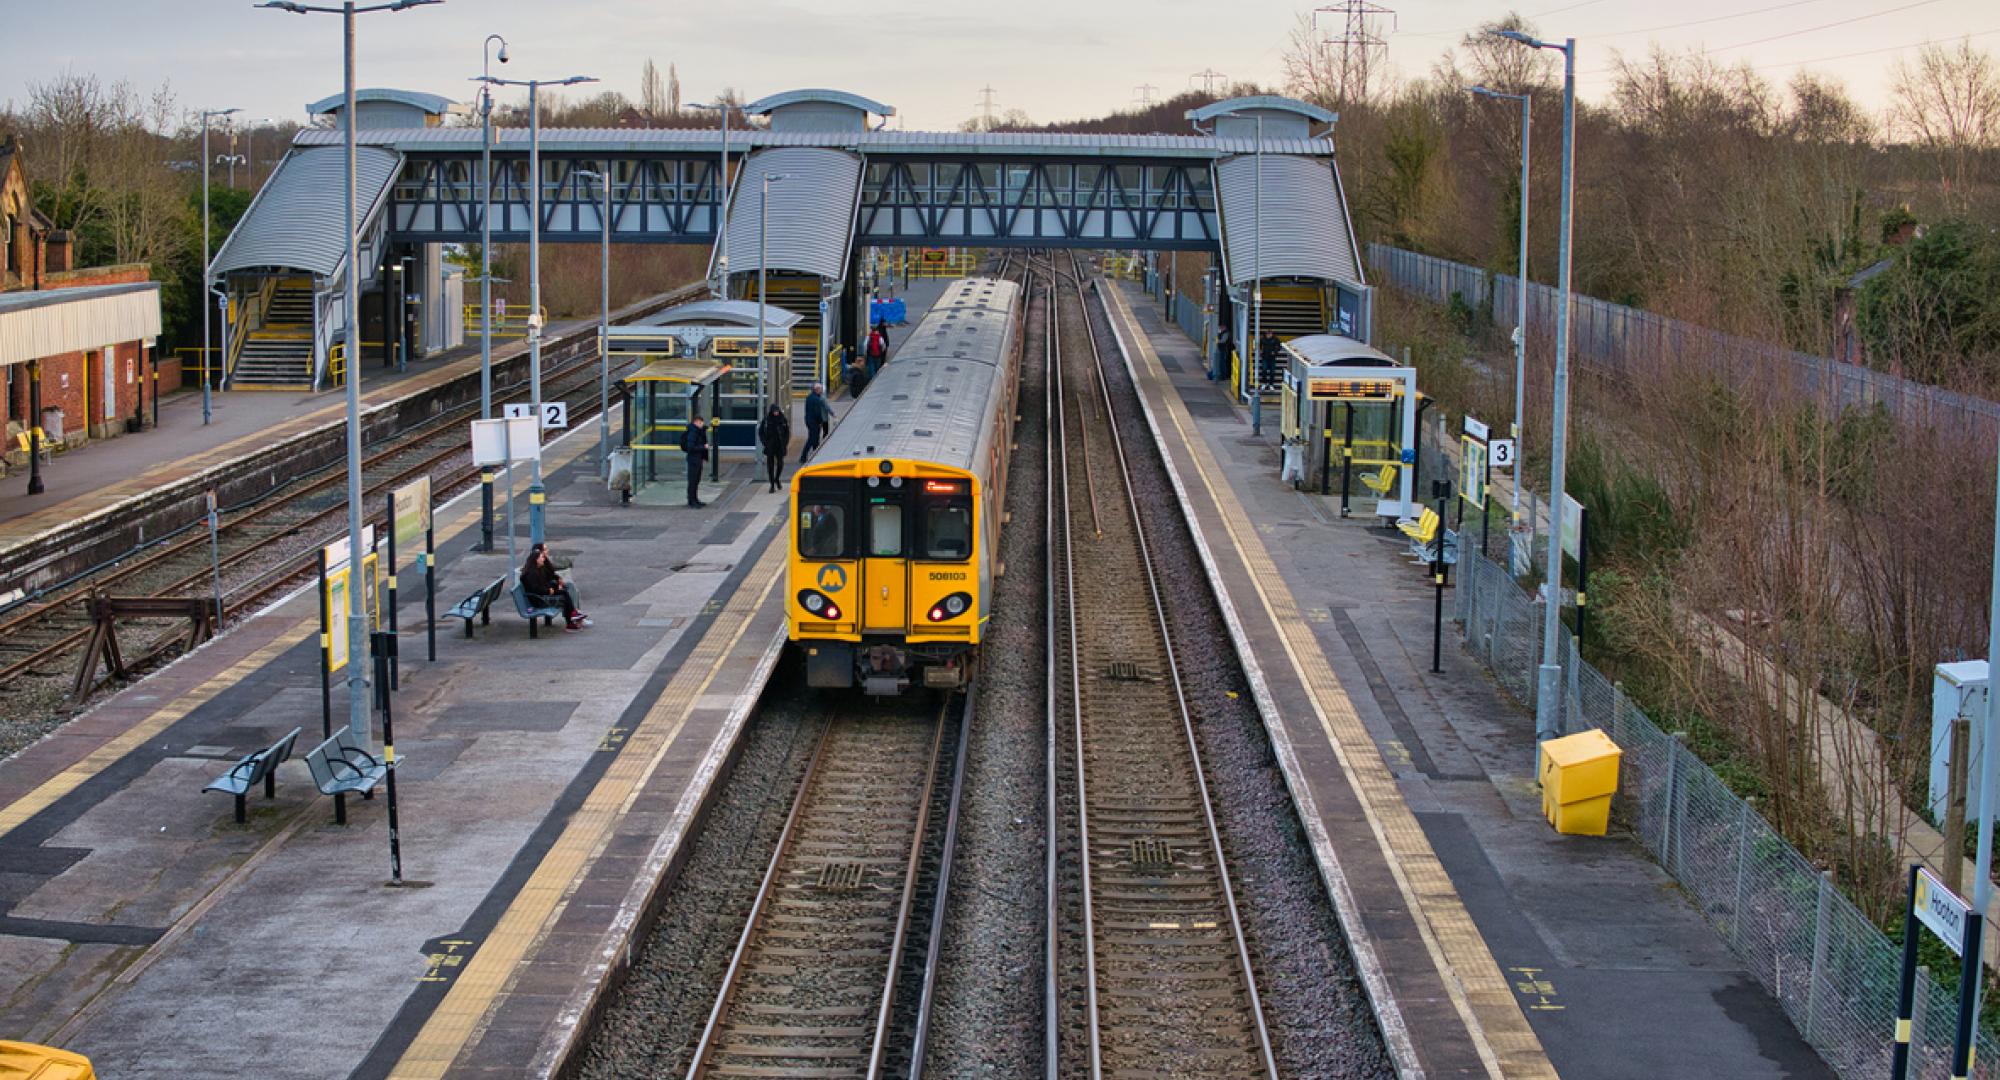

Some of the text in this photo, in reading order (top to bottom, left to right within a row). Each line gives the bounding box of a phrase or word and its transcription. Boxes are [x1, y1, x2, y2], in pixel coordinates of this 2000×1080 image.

[512, 407, 520, 418] 1
[546, 406, 561, 425] 2
[1496, 444, 1508, 462] 3
[928, 572, 967, 581] 508103
[1931, 889, 1959, 931] Hooton
